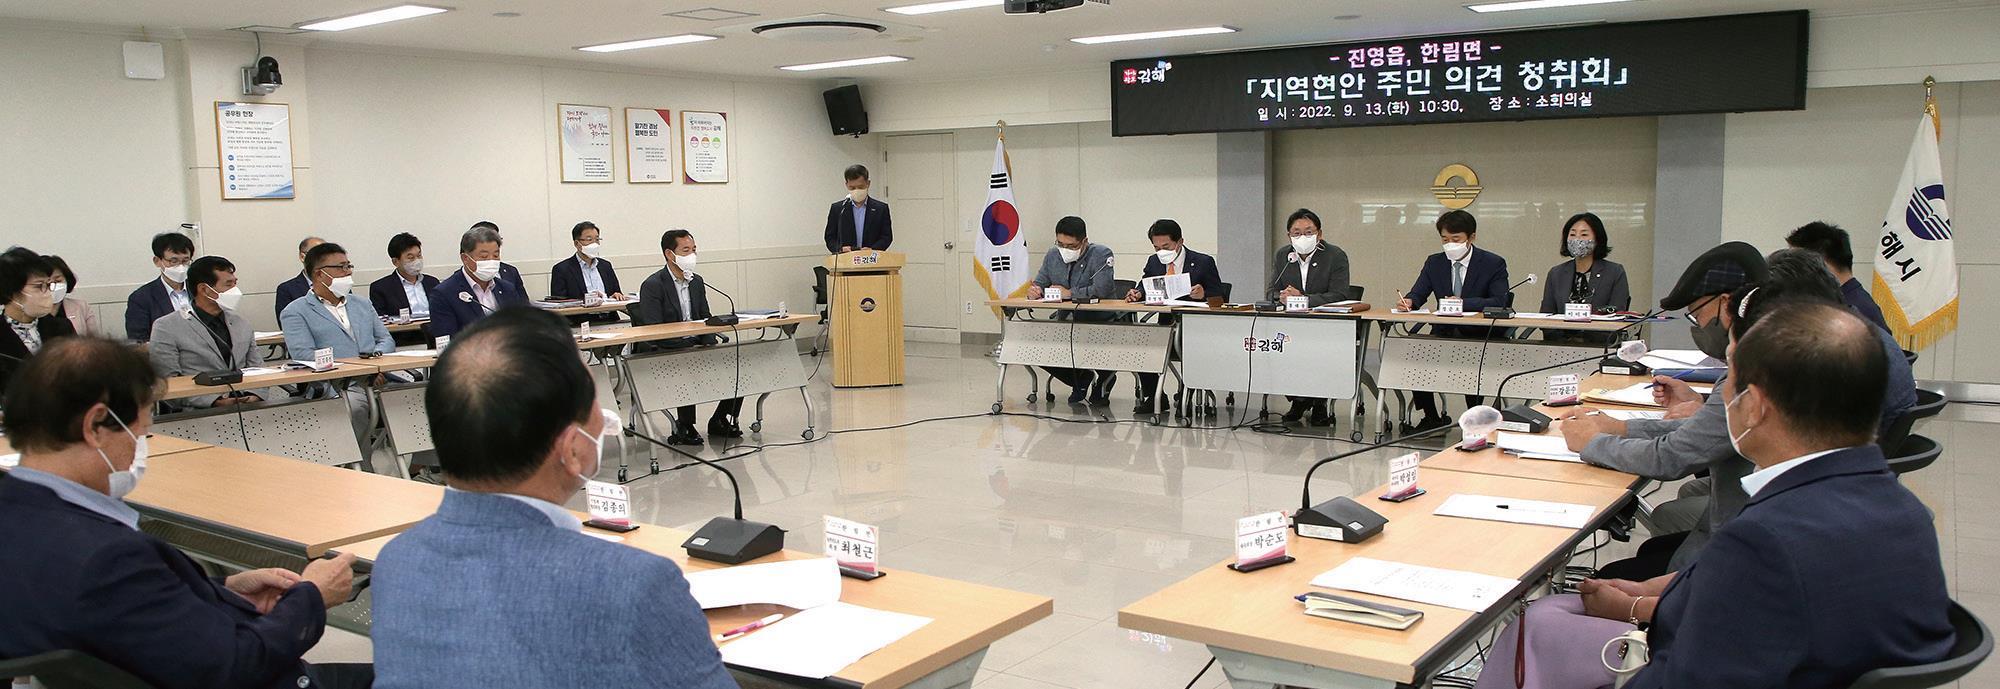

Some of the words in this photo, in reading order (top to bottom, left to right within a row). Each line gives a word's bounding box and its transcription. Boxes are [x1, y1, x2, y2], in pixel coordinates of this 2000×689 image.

[1348, 45, 1412, 69] 진영읍,
[1420, 40, 1481, 64] 한림면
[1137, 66, 1166, 84] 김해
[1377, 69, 1430, 97] 주민
[1445, 64, 1502, 93] 의견
[1535, 92, 1593, 108] 소회의실
[1299, 105, 1336, 118] 2022.
[1343, 104, 1356, 117] 9.
[1880, 221, 1922, 282] 해시
[1258, 338, 1284, 353] 김해
[841, 540, 874, 559] 최철근
[1255, 532, 1284, 549] 박순도
